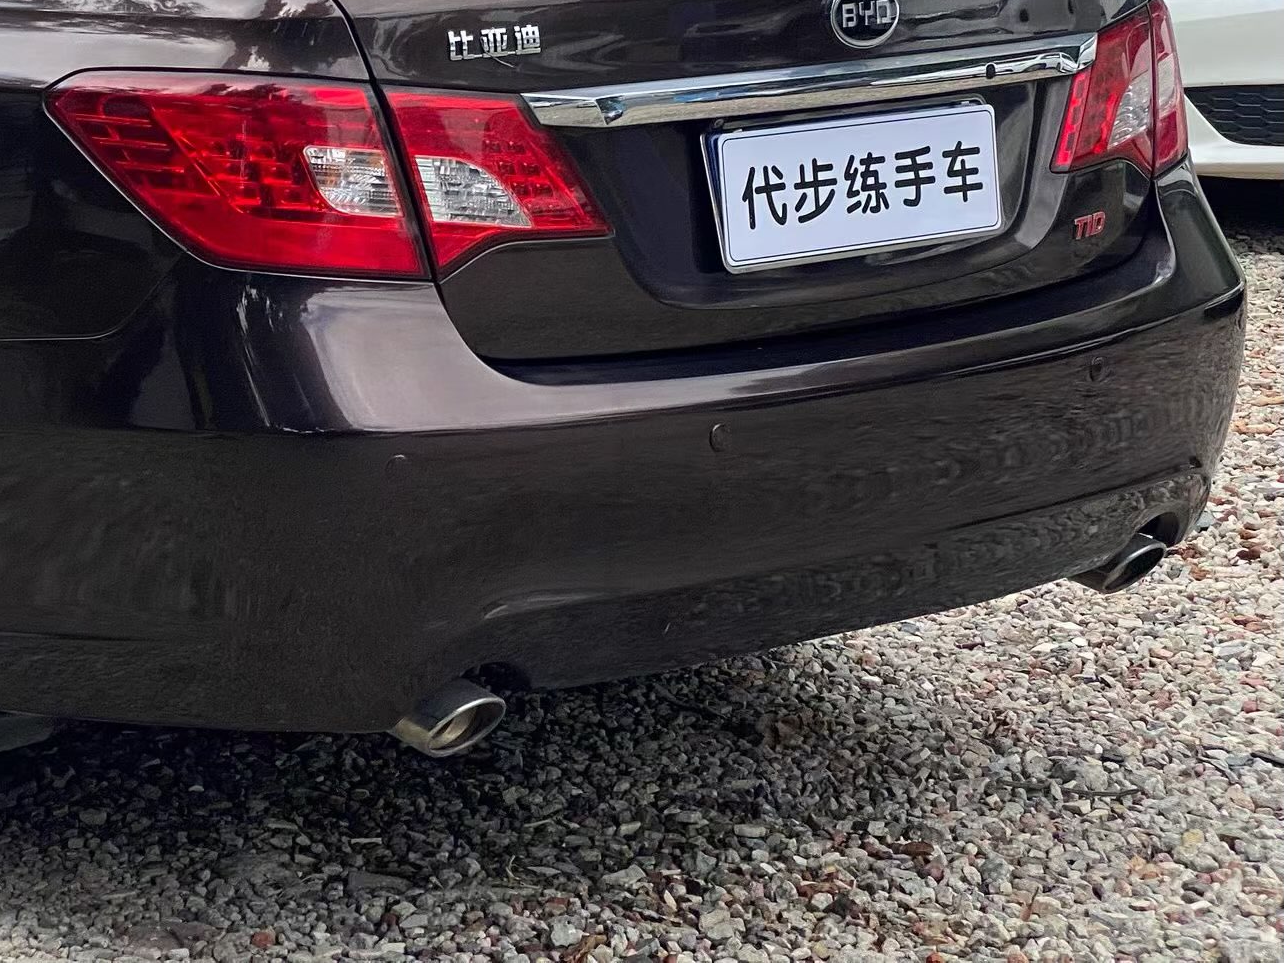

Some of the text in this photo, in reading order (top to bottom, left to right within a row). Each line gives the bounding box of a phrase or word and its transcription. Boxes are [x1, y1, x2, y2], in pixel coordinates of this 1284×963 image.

[842, 0, 892, 28] BYD
[448, 24, 541, 61] 比亚迪
[742, 140, 984, 230] 代步练手车
[1074, 211, 1106, 240] TID
